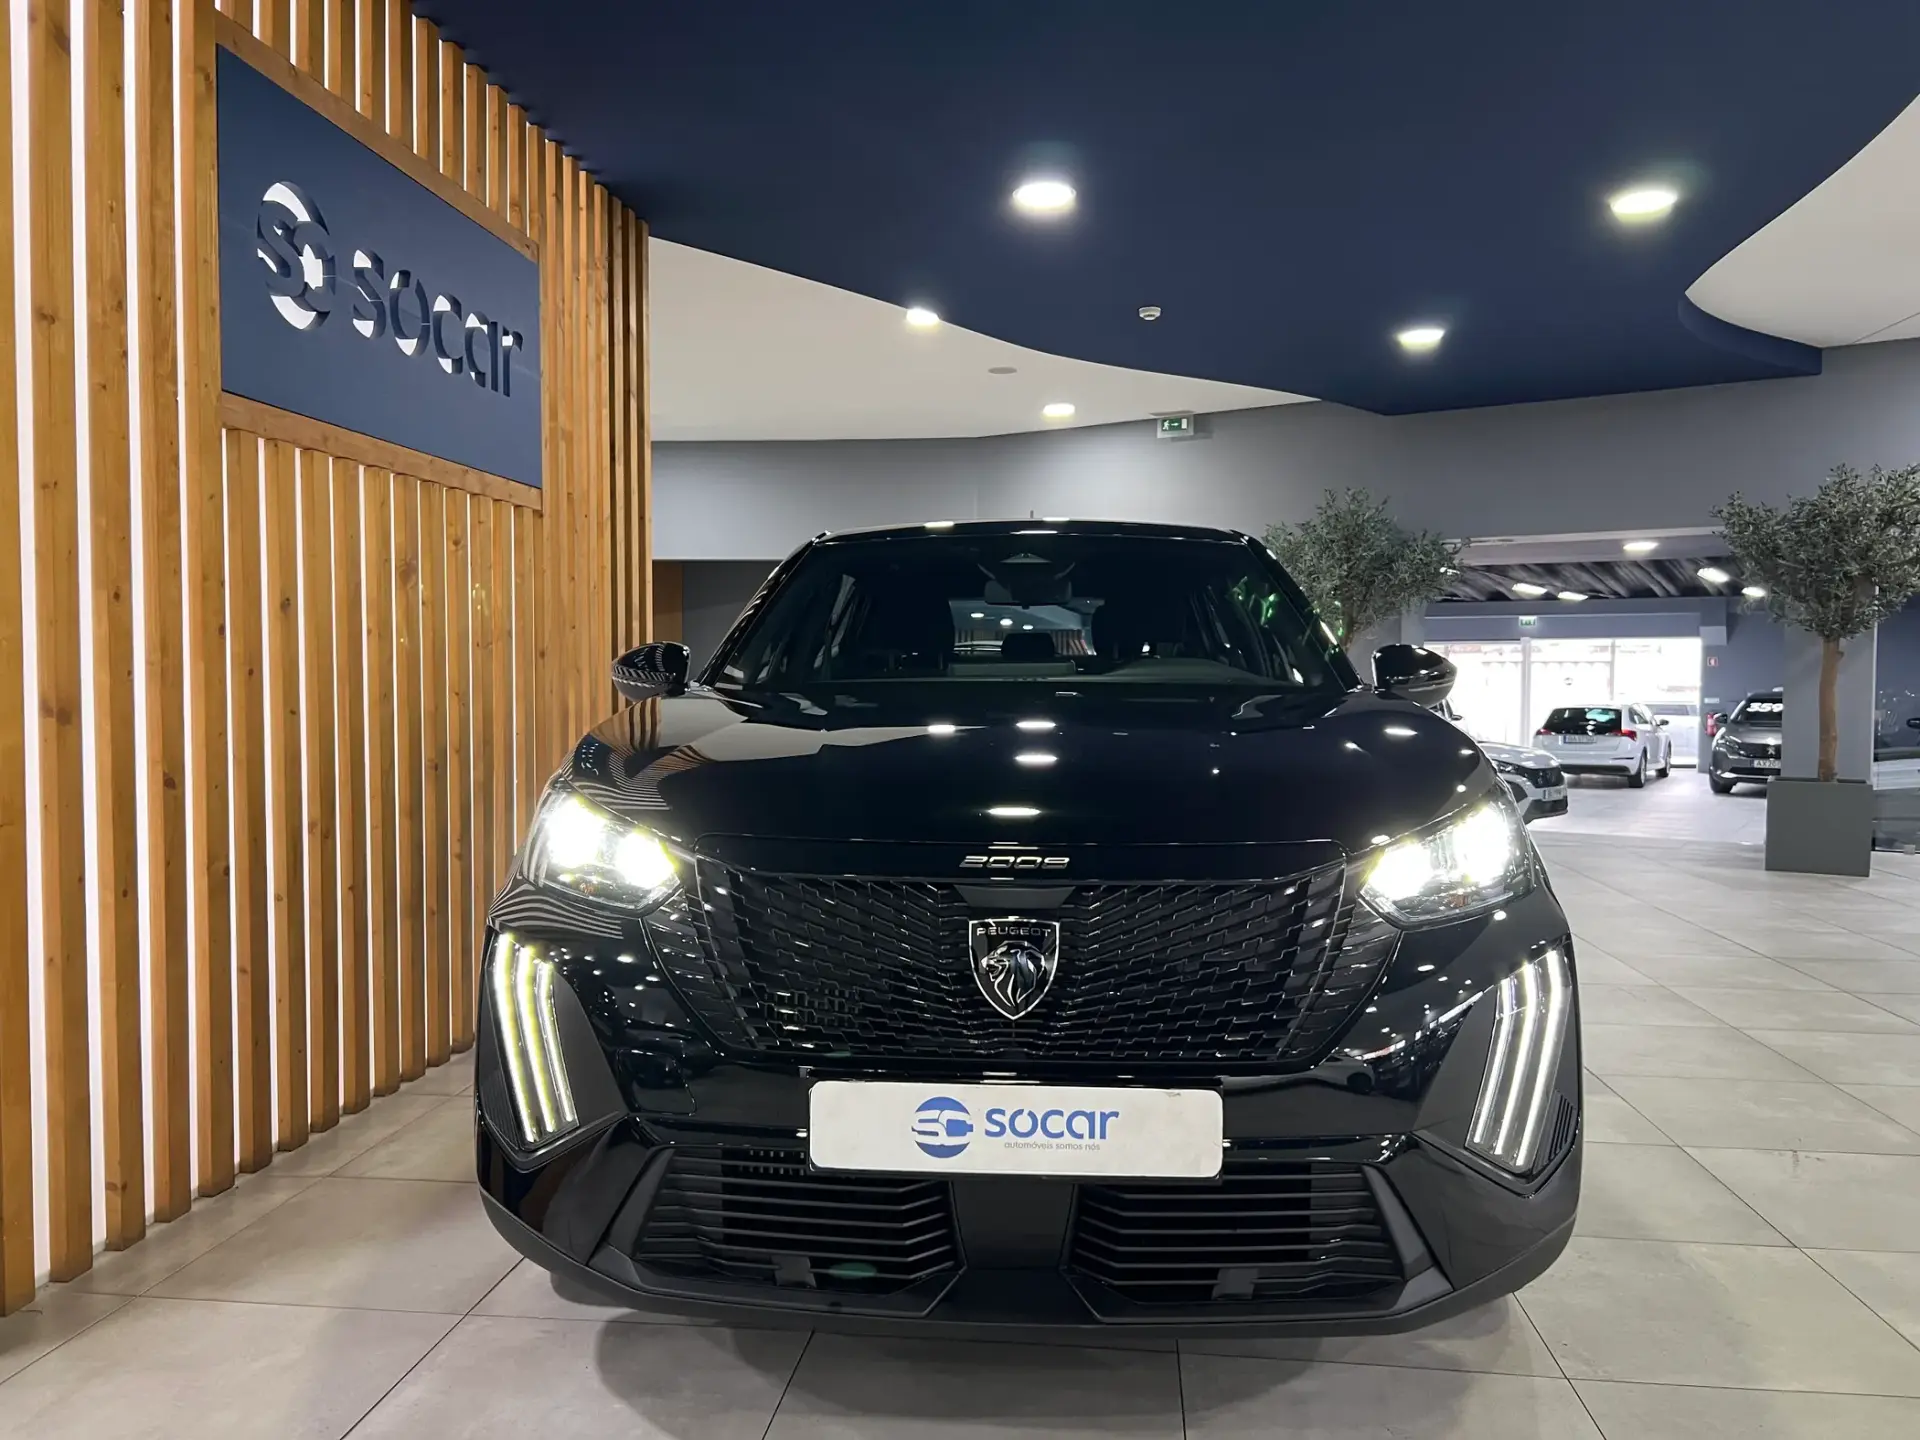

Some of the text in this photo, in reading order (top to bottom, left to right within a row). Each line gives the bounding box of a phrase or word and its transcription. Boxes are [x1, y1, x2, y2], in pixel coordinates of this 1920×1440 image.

[352, 249, 524, 398] socar
[976, 926, 1052, 937] PEUGEOT
[984, 1107, 1120, 1140] socar
[1004, 1140, 1101, 1151] automóveis somos nós
